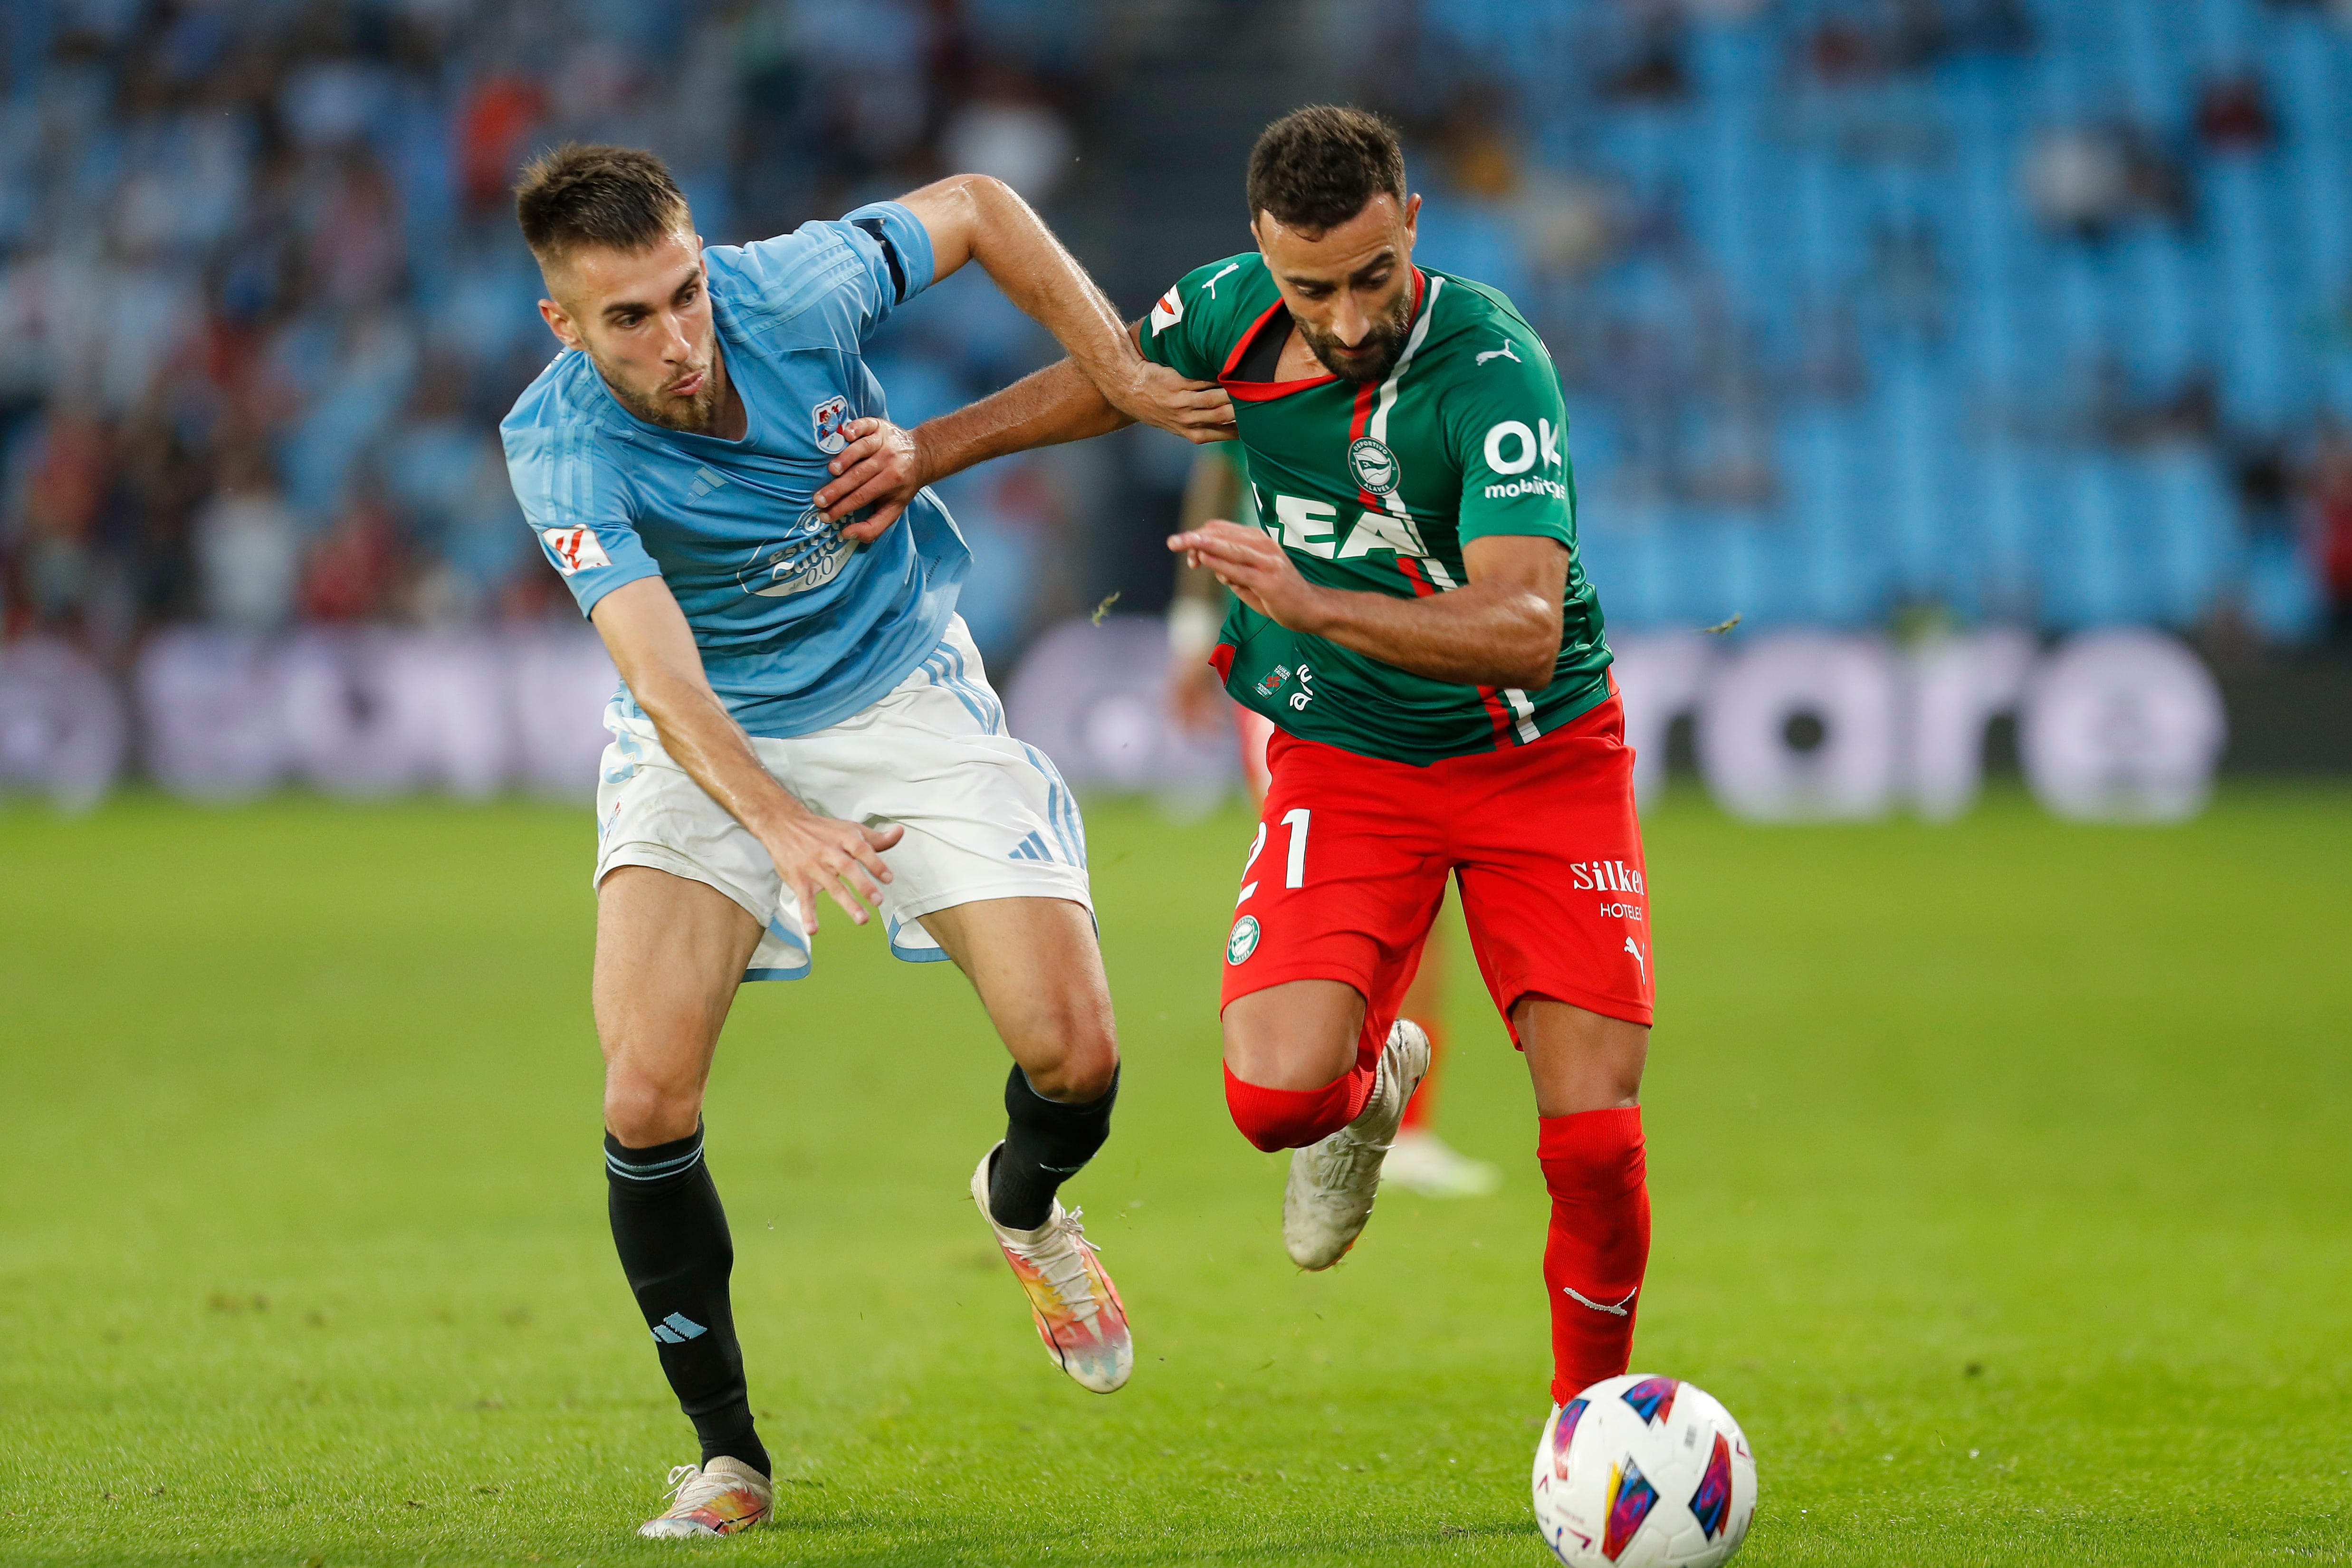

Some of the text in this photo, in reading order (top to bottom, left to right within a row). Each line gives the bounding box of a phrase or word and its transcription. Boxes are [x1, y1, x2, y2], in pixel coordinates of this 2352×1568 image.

[1353, 440, 1388, 455] DEPORTIVO
[1483, 418, 1562, 475] OK
[1235, 808, 1311, 910] 21
[1600, 902, 1643, 921] HOTELES
